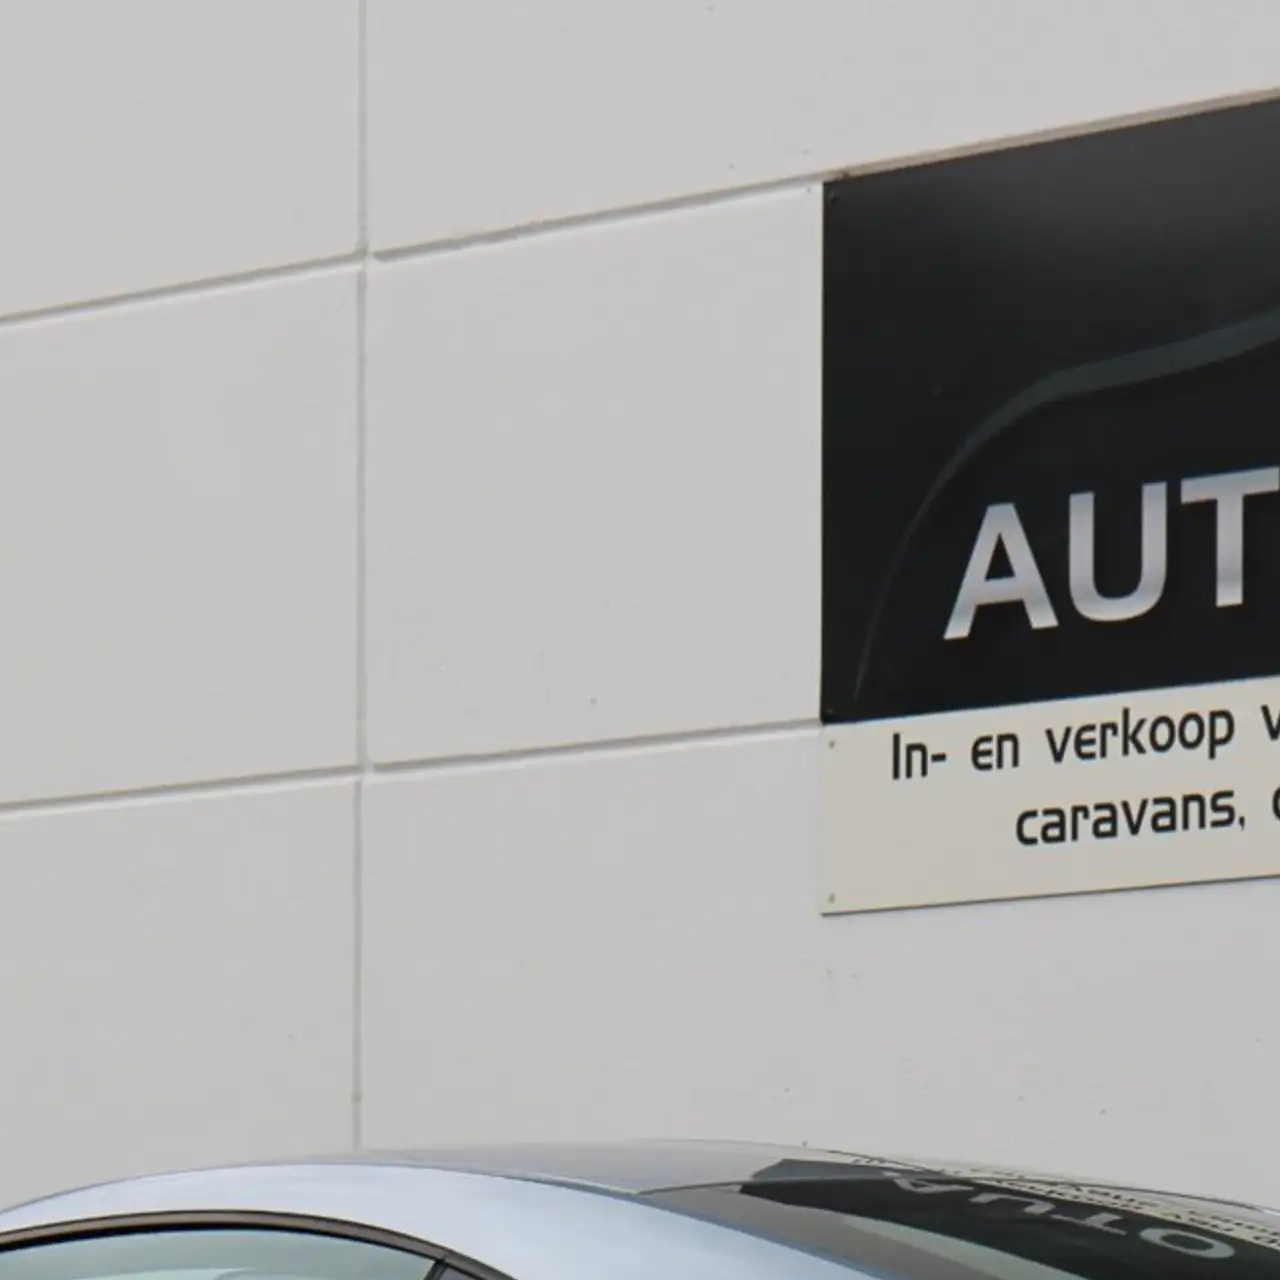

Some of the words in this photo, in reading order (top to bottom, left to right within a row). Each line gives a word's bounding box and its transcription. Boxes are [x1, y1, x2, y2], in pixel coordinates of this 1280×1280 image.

[891, 731, 948, 781] In-
[970, 732, 1020, 772] en
[1044, 706, 1237, 765] verkoop
[1014, 782, 1248, 848] caravans,
